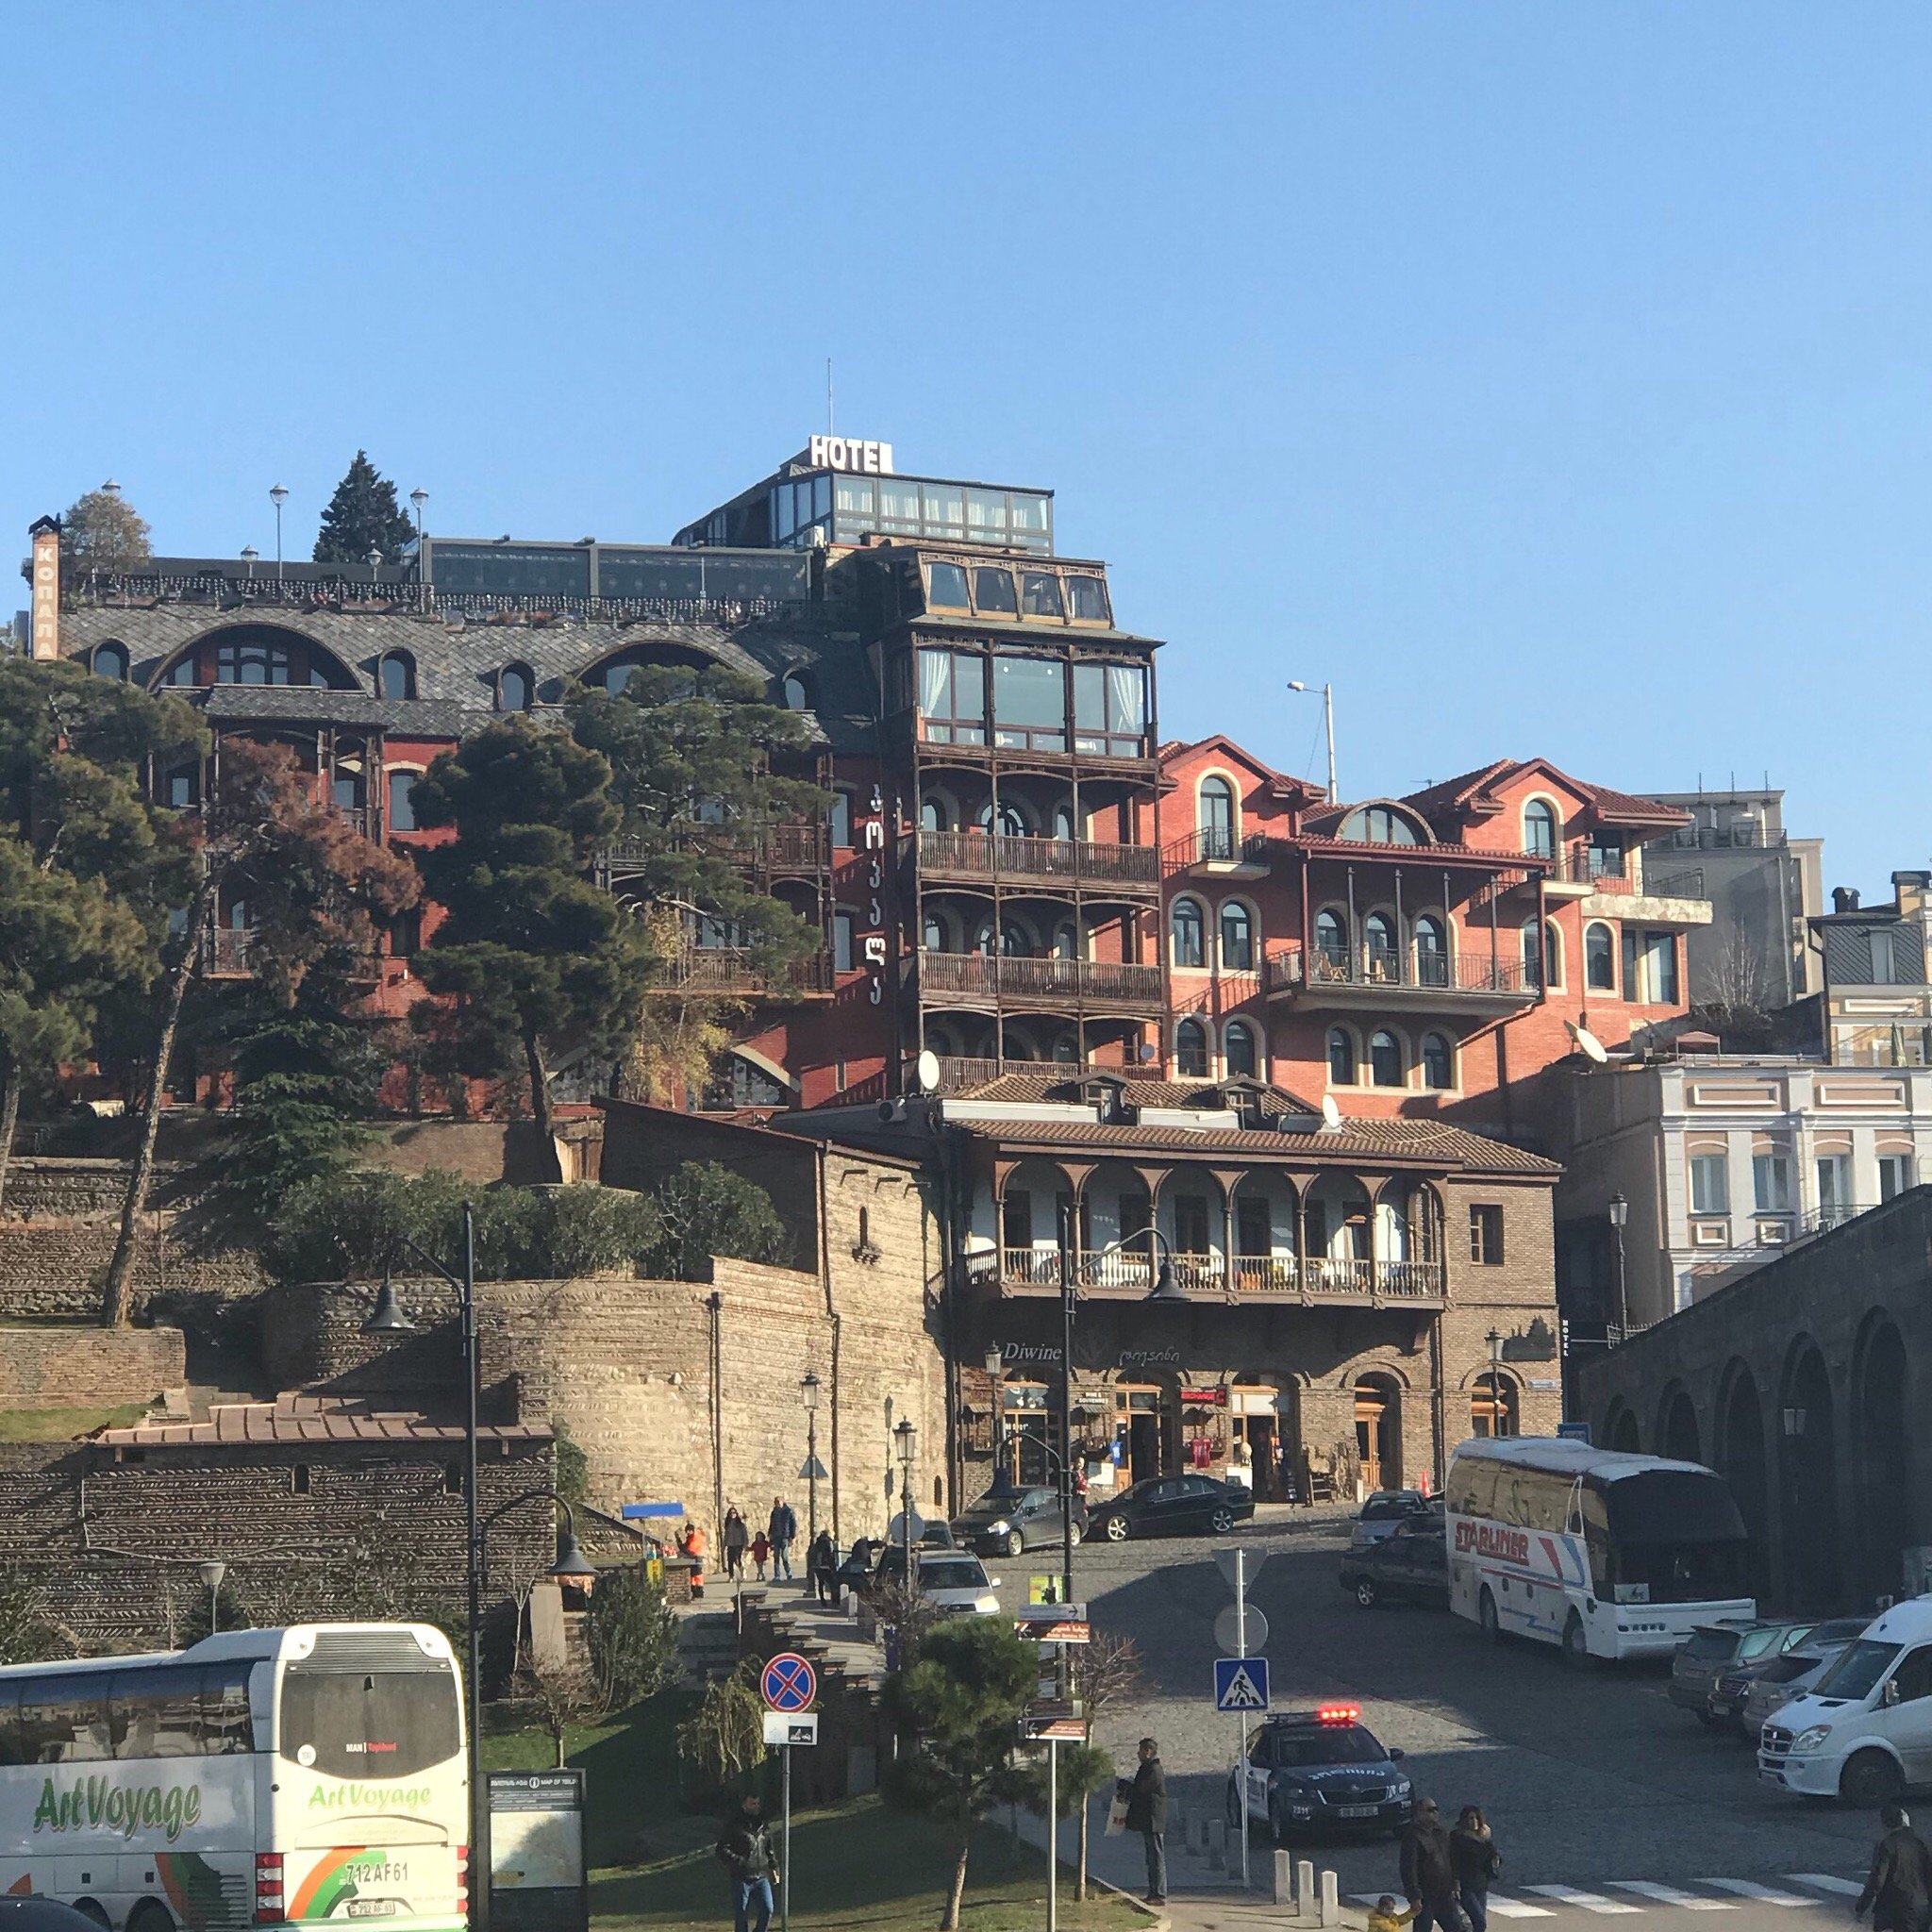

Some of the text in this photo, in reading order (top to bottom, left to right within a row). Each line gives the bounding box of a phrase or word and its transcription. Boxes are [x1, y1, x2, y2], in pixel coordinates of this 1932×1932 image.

[810, 434, 893, 474] HOTEL
[37, 547, 56, 658] КОПАЛА
[1004, 1342, 1062, 1359] Diwine
